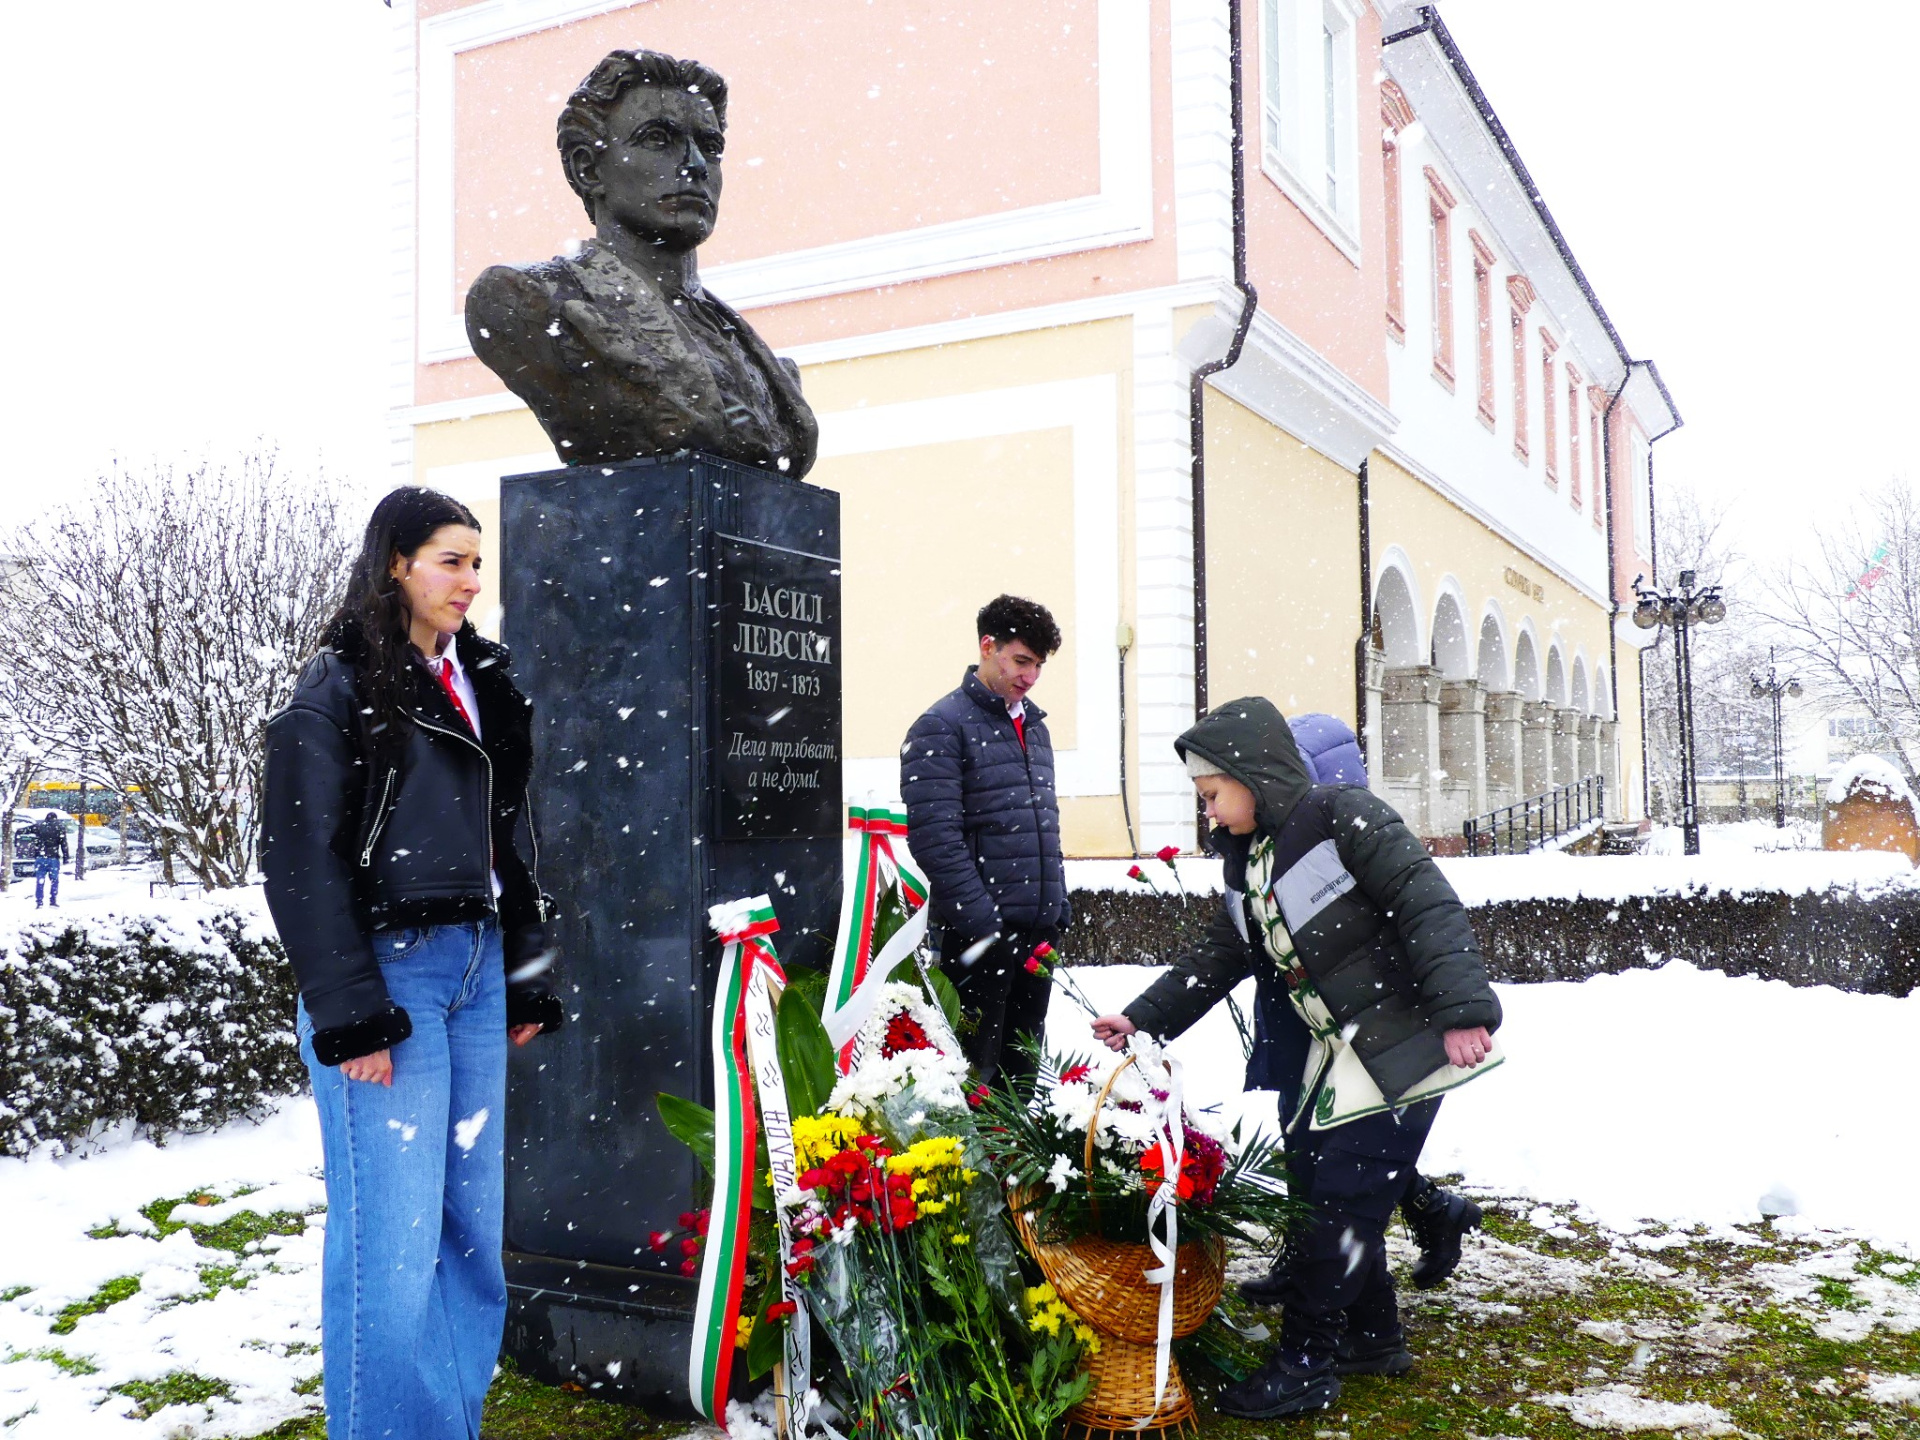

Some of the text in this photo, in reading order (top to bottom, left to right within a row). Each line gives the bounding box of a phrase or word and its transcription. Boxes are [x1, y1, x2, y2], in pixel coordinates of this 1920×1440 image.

[743, 582, 823, 624] ВАСИЛ
[733, 622, 832, 664] ЛЕВСКИ
[747, 669, 778, 692] 1837
[791, 674, 820, 696] 1873
[728, 732, 838, 763] Дела трябват,
[748, 765, 820, 794] а не думи.
